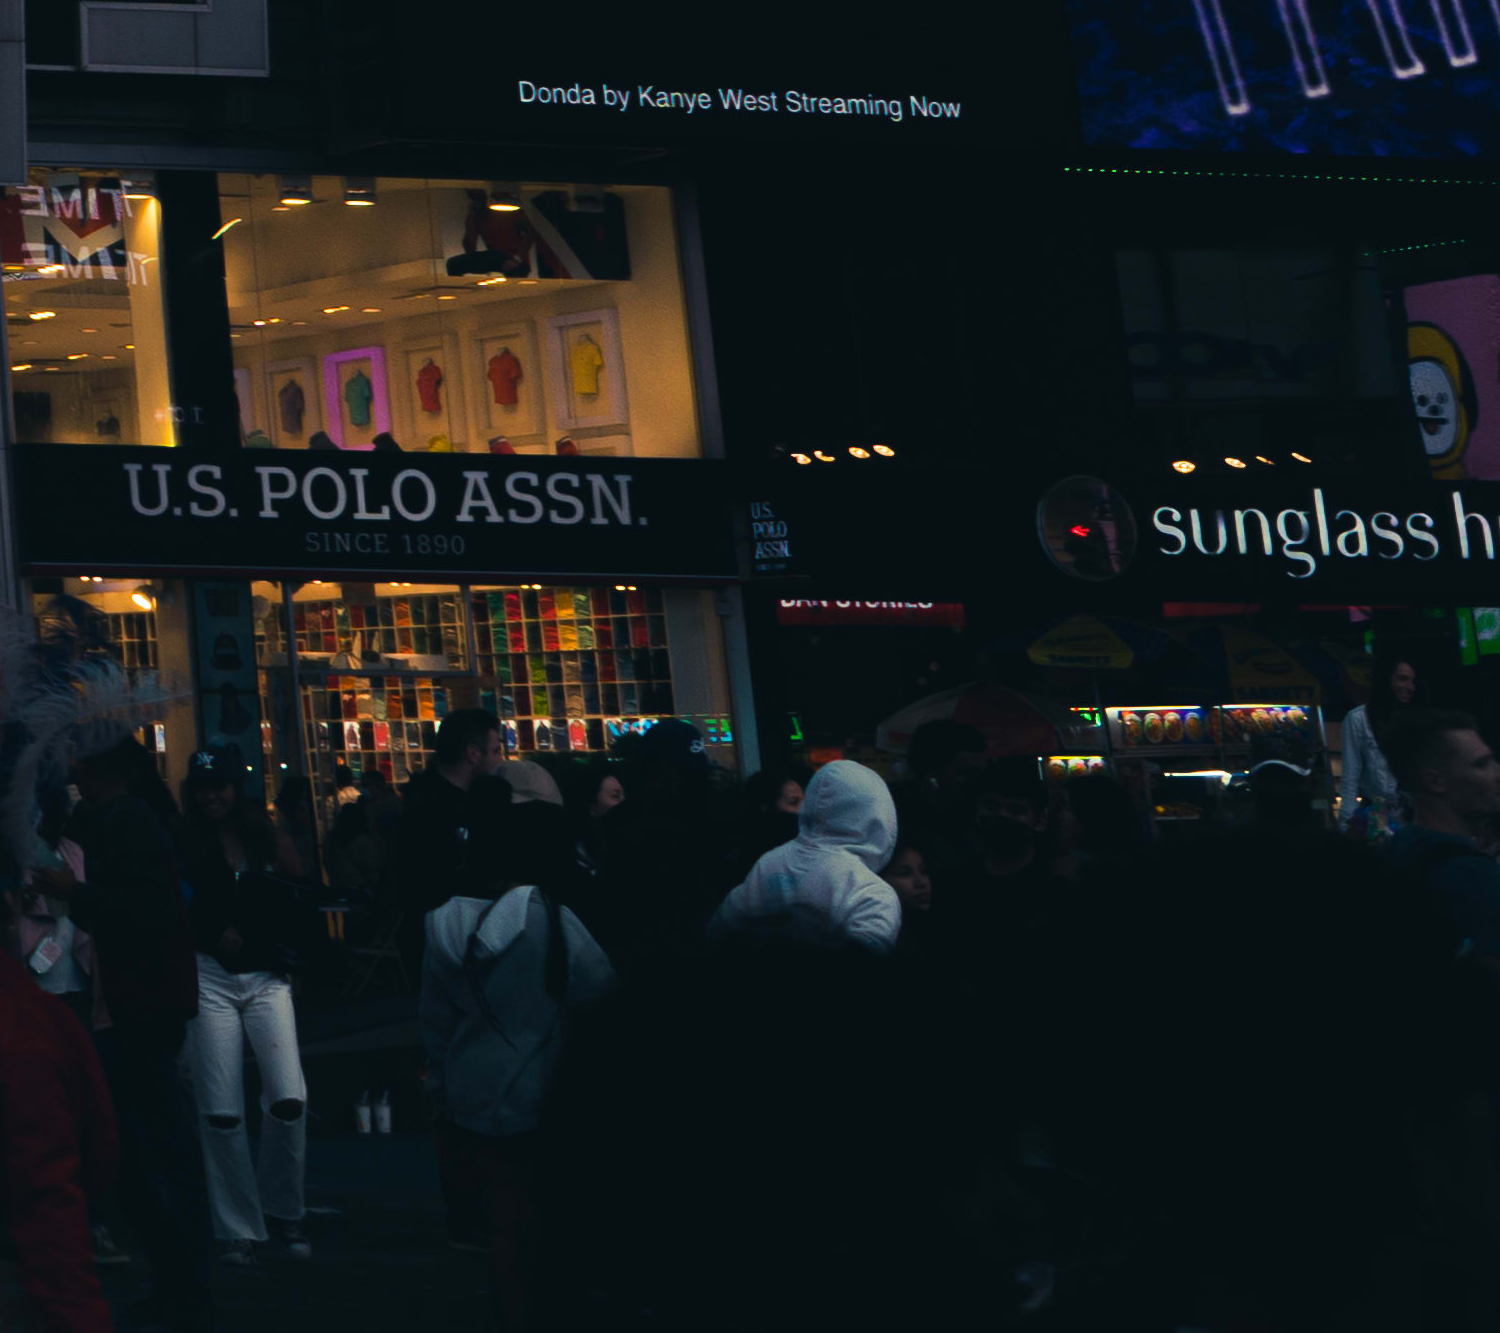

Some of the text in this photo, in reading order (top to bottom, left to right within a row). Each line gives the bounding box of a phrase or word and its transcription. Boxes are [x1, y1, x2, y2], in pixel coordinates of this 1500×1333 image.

[518, 80, 962, 122] Donda by Kanye West Streaming Now
[124, 463, 649, 527] U.S. POLO ASSN.
[306, 532, 466, 557] SINCE 1890
[1151, 487, 1500, 579] sunglass h
